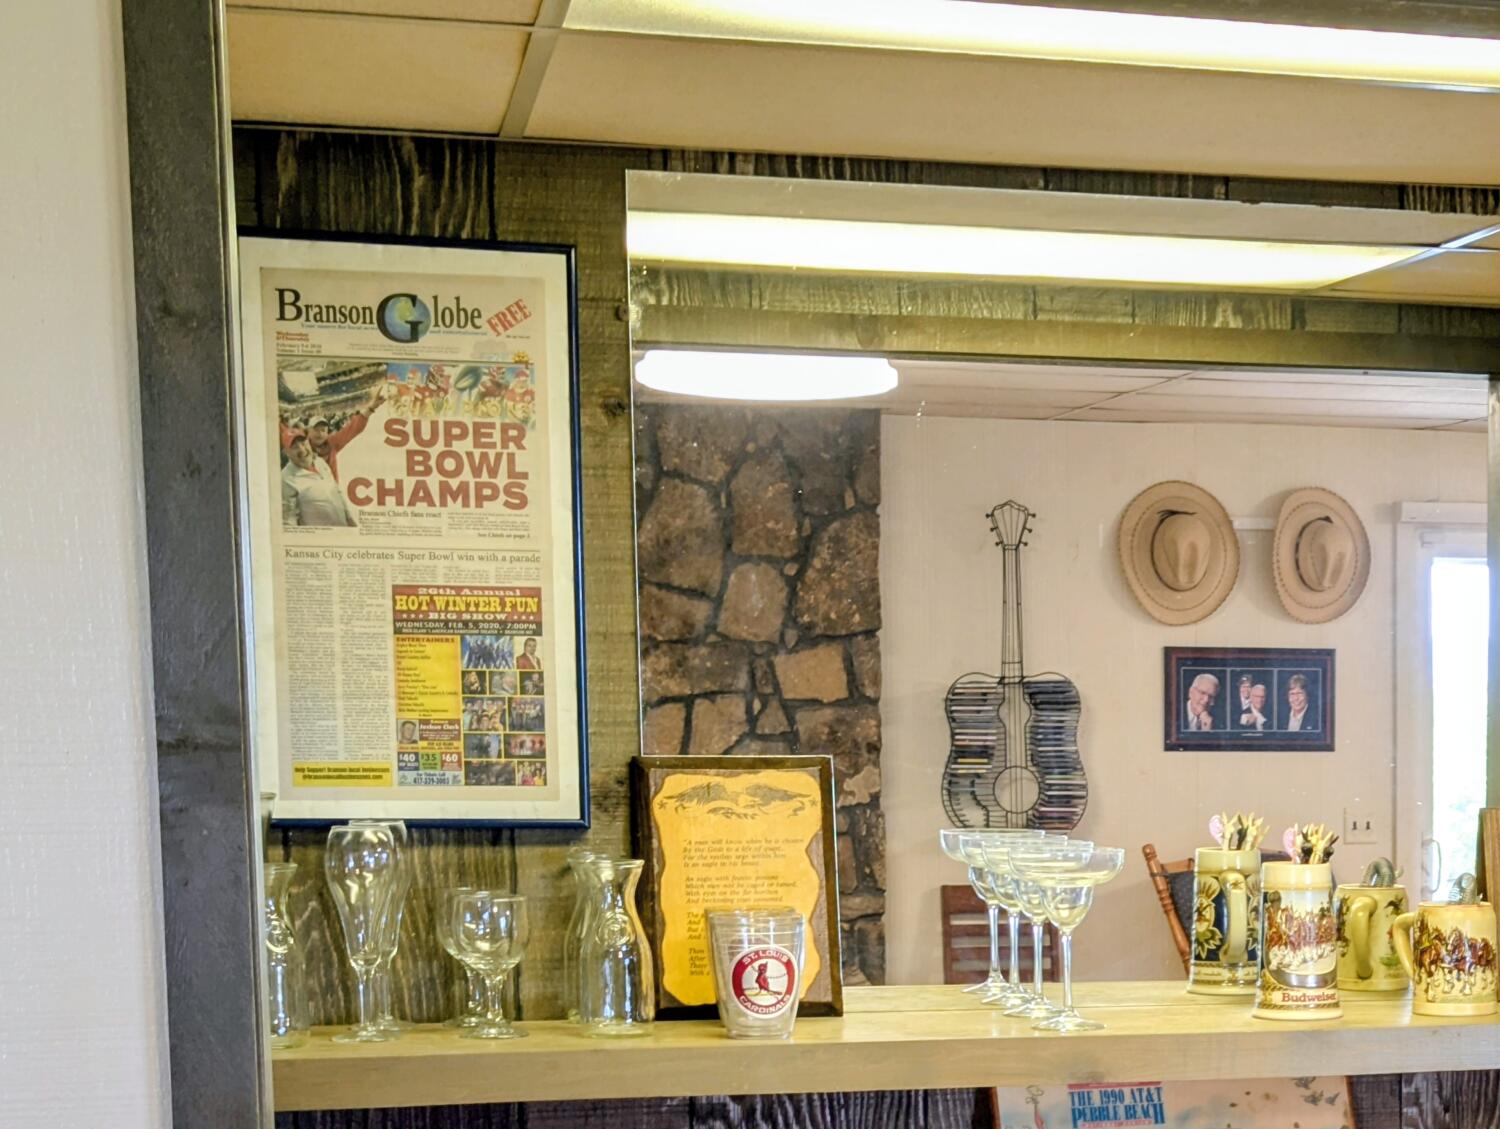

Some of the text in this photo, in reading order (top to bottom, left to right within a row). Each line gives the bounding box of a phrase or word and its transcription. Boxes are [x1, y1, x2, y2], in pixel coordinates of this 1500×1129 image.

[275, 288, 482, 343] Branson Globe
[486, 298, 532, 337] FREE
[383, 418, 527, 450] SUPER
[406, 449, 529, 480] BOWL
[347, 477, 529, 511] CHAMPS
[285, 549, 320, 559] Kansas
[322, 550, 343, 561] City
[346, 551, 395, 560] celebrates
[397, 551, 426, 562] Super
[429, 552, 454, 561] Bowl
[457, 553, 475, 561] win
[476, 553, 498, 562] with
[509, 554, 541, 564] parade
[461, 588, 521, 596] Annual
[395, 595, 538, 612] HOT WINTER FUN
[428, 612, 457, 620] BIG
[742, 950, 789, 965] ST. LOUIS
[739, 995, 791, 1014] CARDINALS
[1069, 1086, 1163, 1106] THE 1990 AT&T
[1071, 1104, 1121, 1129] PEBBLE
[1124, 1103, 1165, 1124] BEACH
